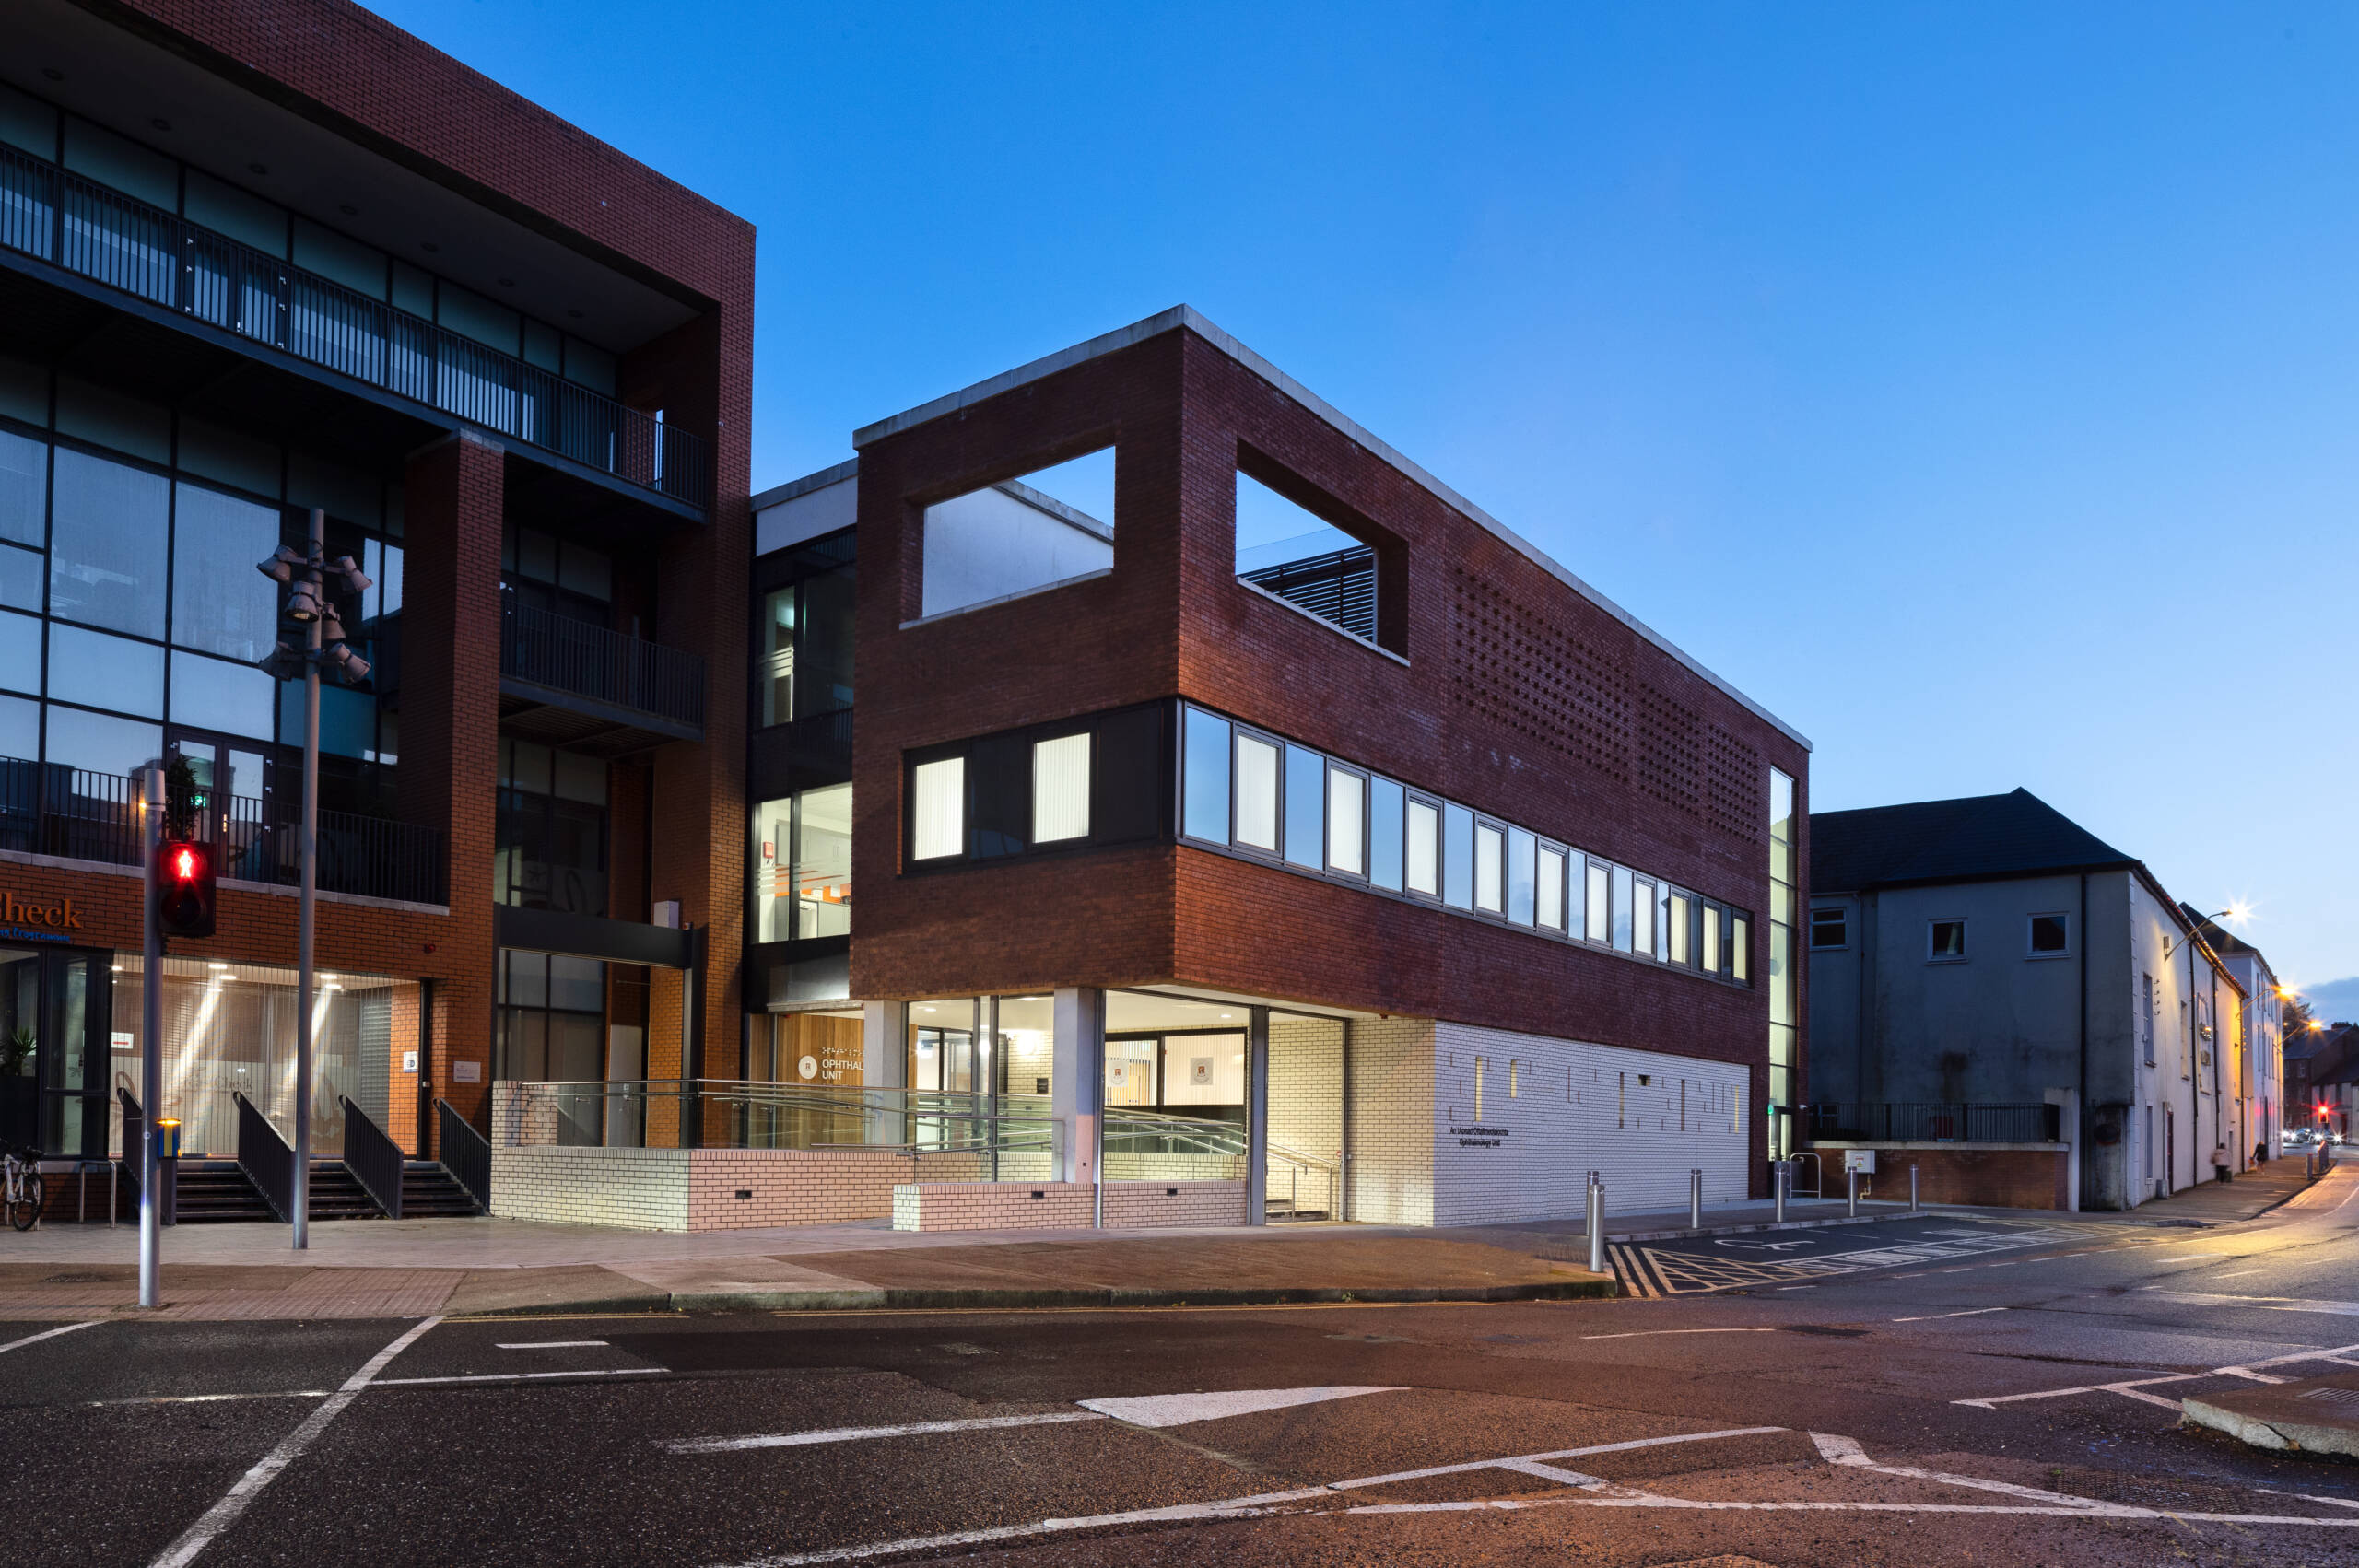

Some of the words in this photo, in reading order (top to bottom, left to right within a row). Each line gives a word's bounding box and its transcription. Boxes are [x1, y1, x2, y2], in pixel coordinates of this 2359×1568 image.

[0, 892, 83, 928] heck
[822, 1059, 863, 1071] OPHTHAL
[822, 1071, 843, 1079] UNIT
